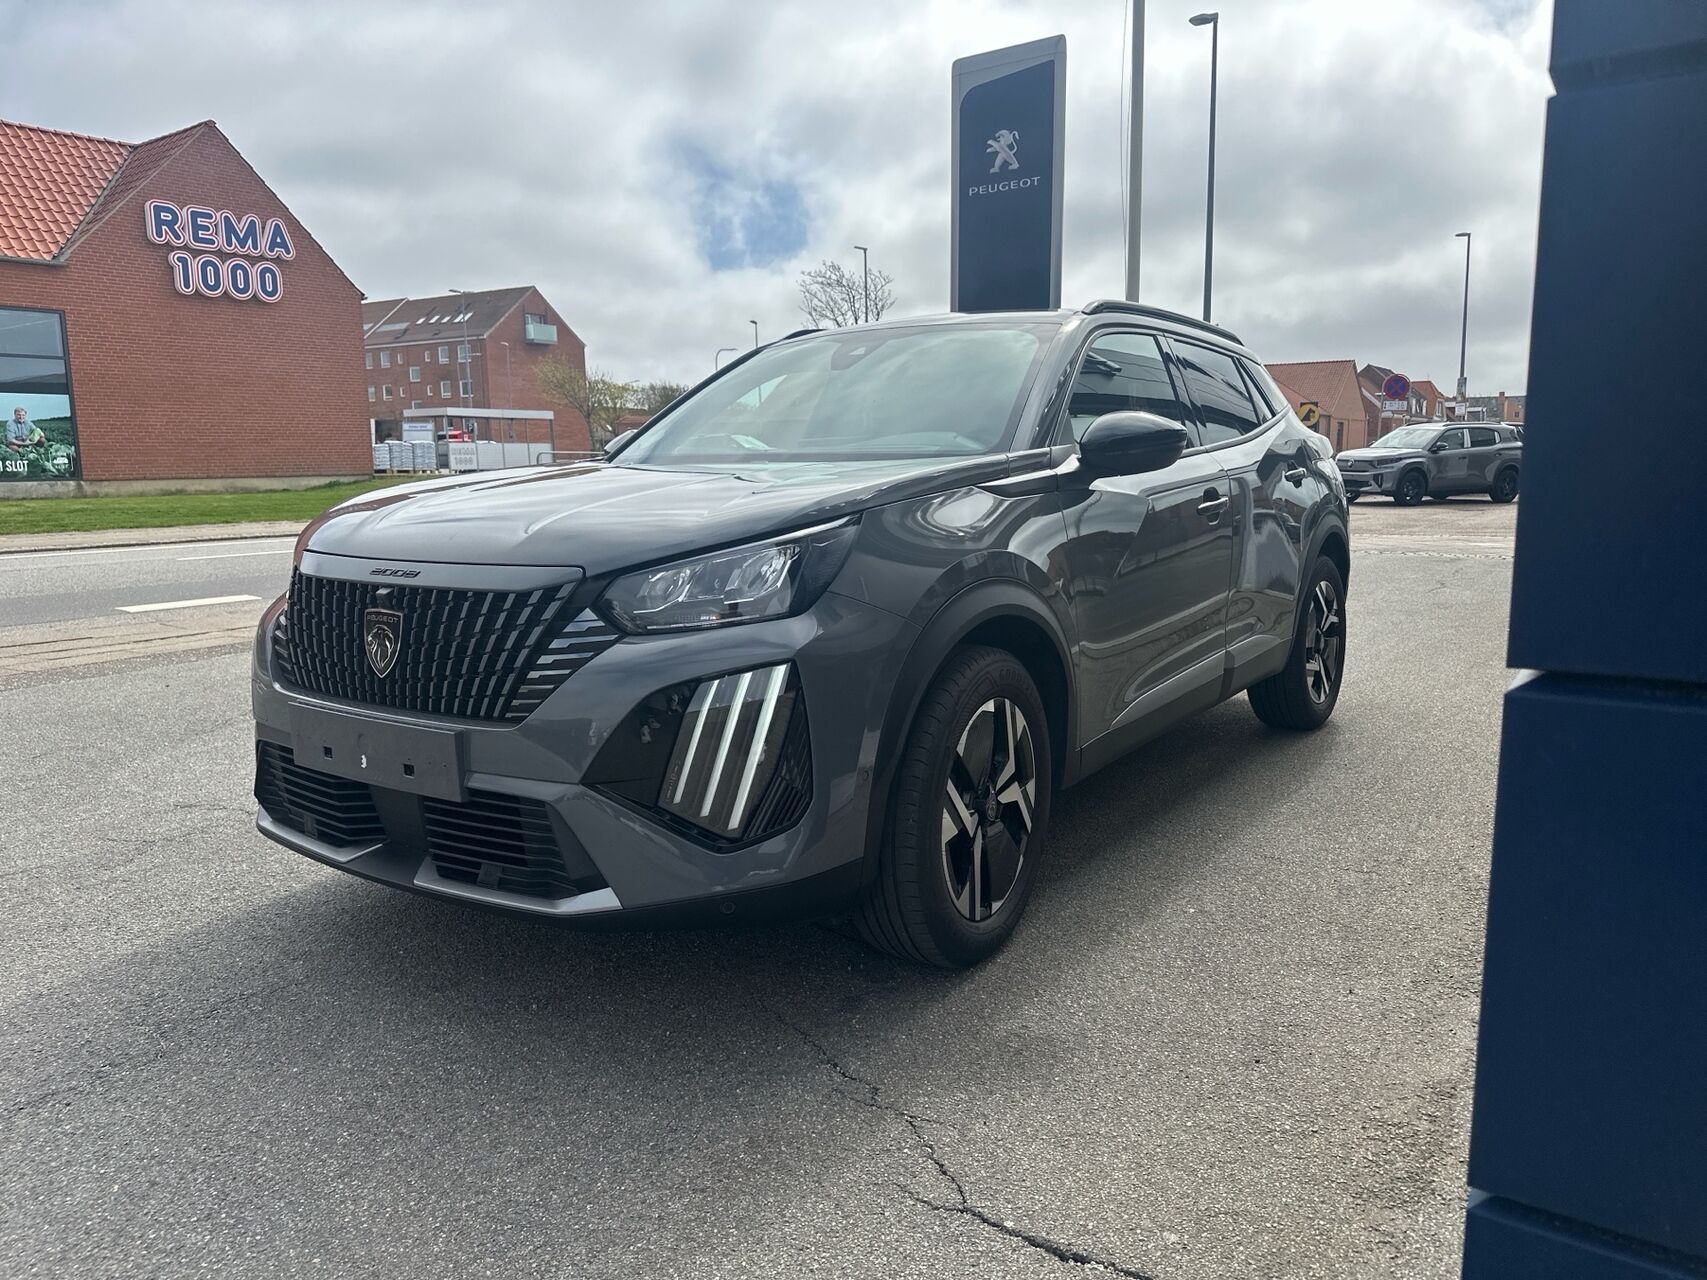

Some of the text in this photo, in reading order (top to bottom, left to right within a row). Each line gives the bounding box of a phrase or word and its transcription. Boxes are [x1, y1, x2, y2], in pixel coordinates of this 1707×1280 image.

[968, 176, 1041, 196] PEUGEOT
[144, 199, 296, 261] REMA
[168, 250, 283, 303] 1000
[5, 461, 29, 472] SLOT
[369, 567, 421, 578] 2008
[366, 614, 399, 623] PEUGEOT
